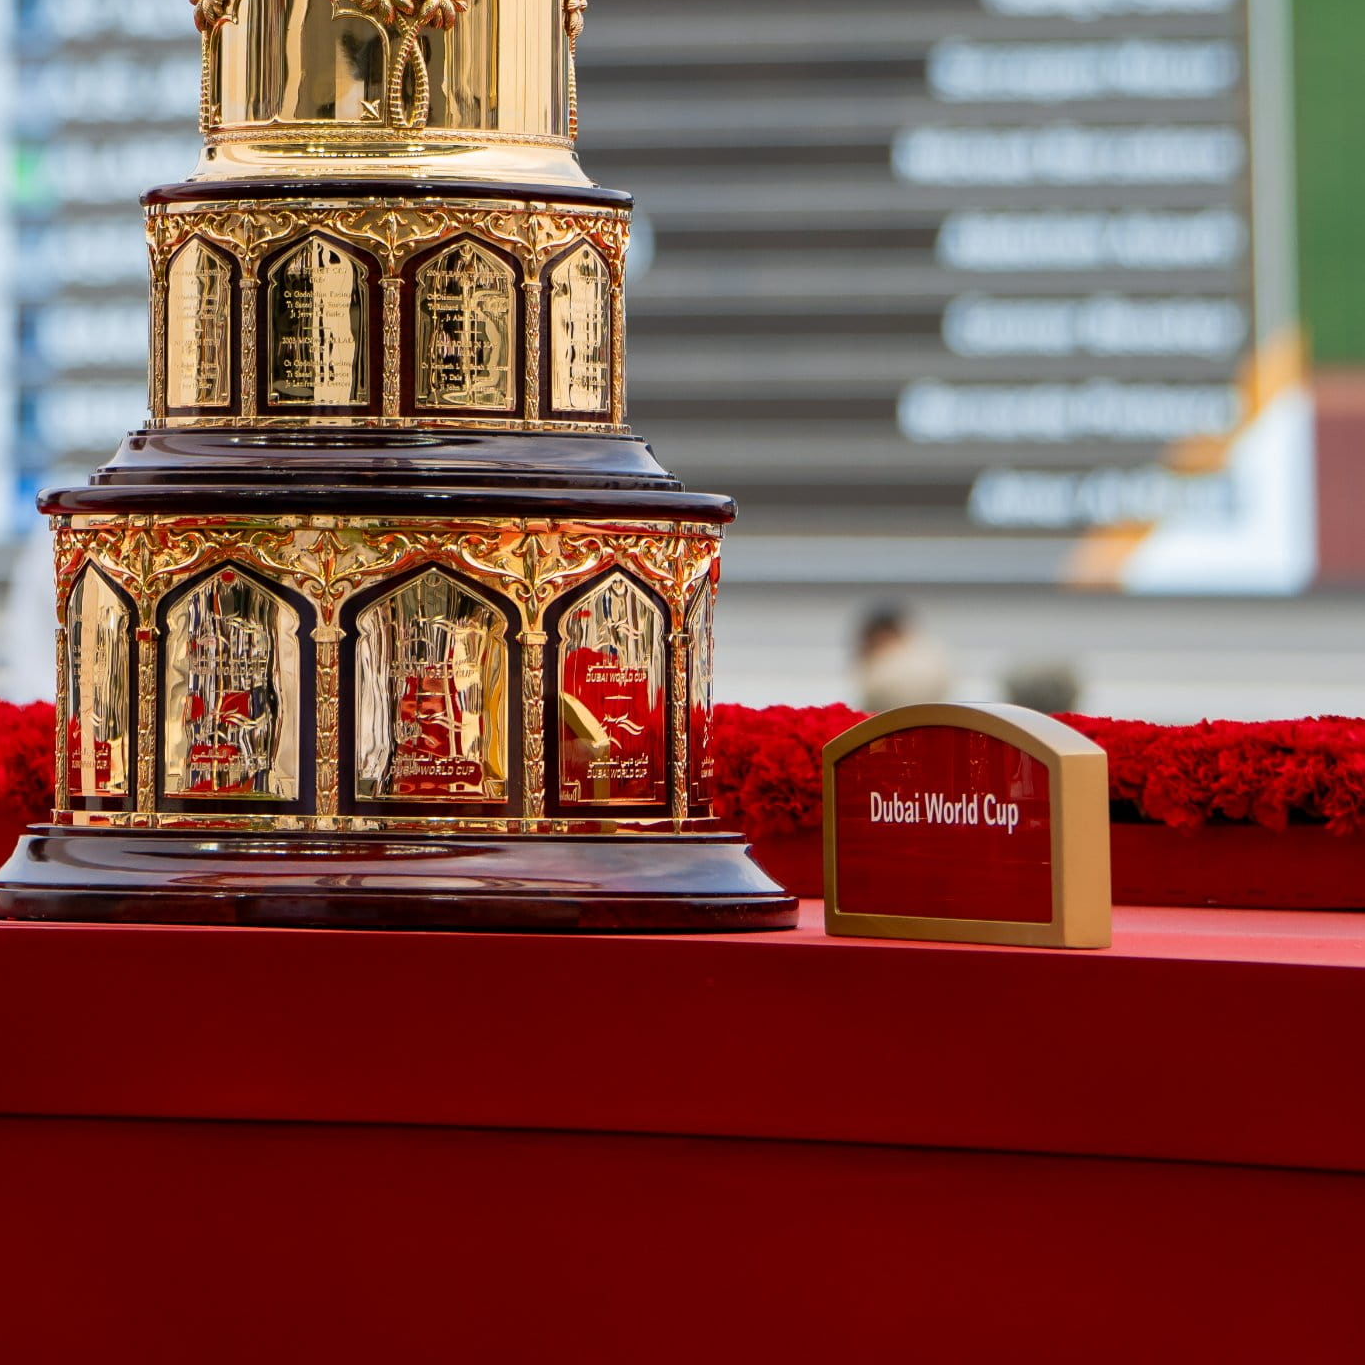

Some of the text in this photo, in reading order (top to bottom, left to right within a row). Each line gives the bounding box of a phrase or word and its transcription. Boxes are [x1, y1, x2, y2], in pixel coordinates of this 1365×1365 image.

[869, 791, 1020, 835] Dubai World Cup
